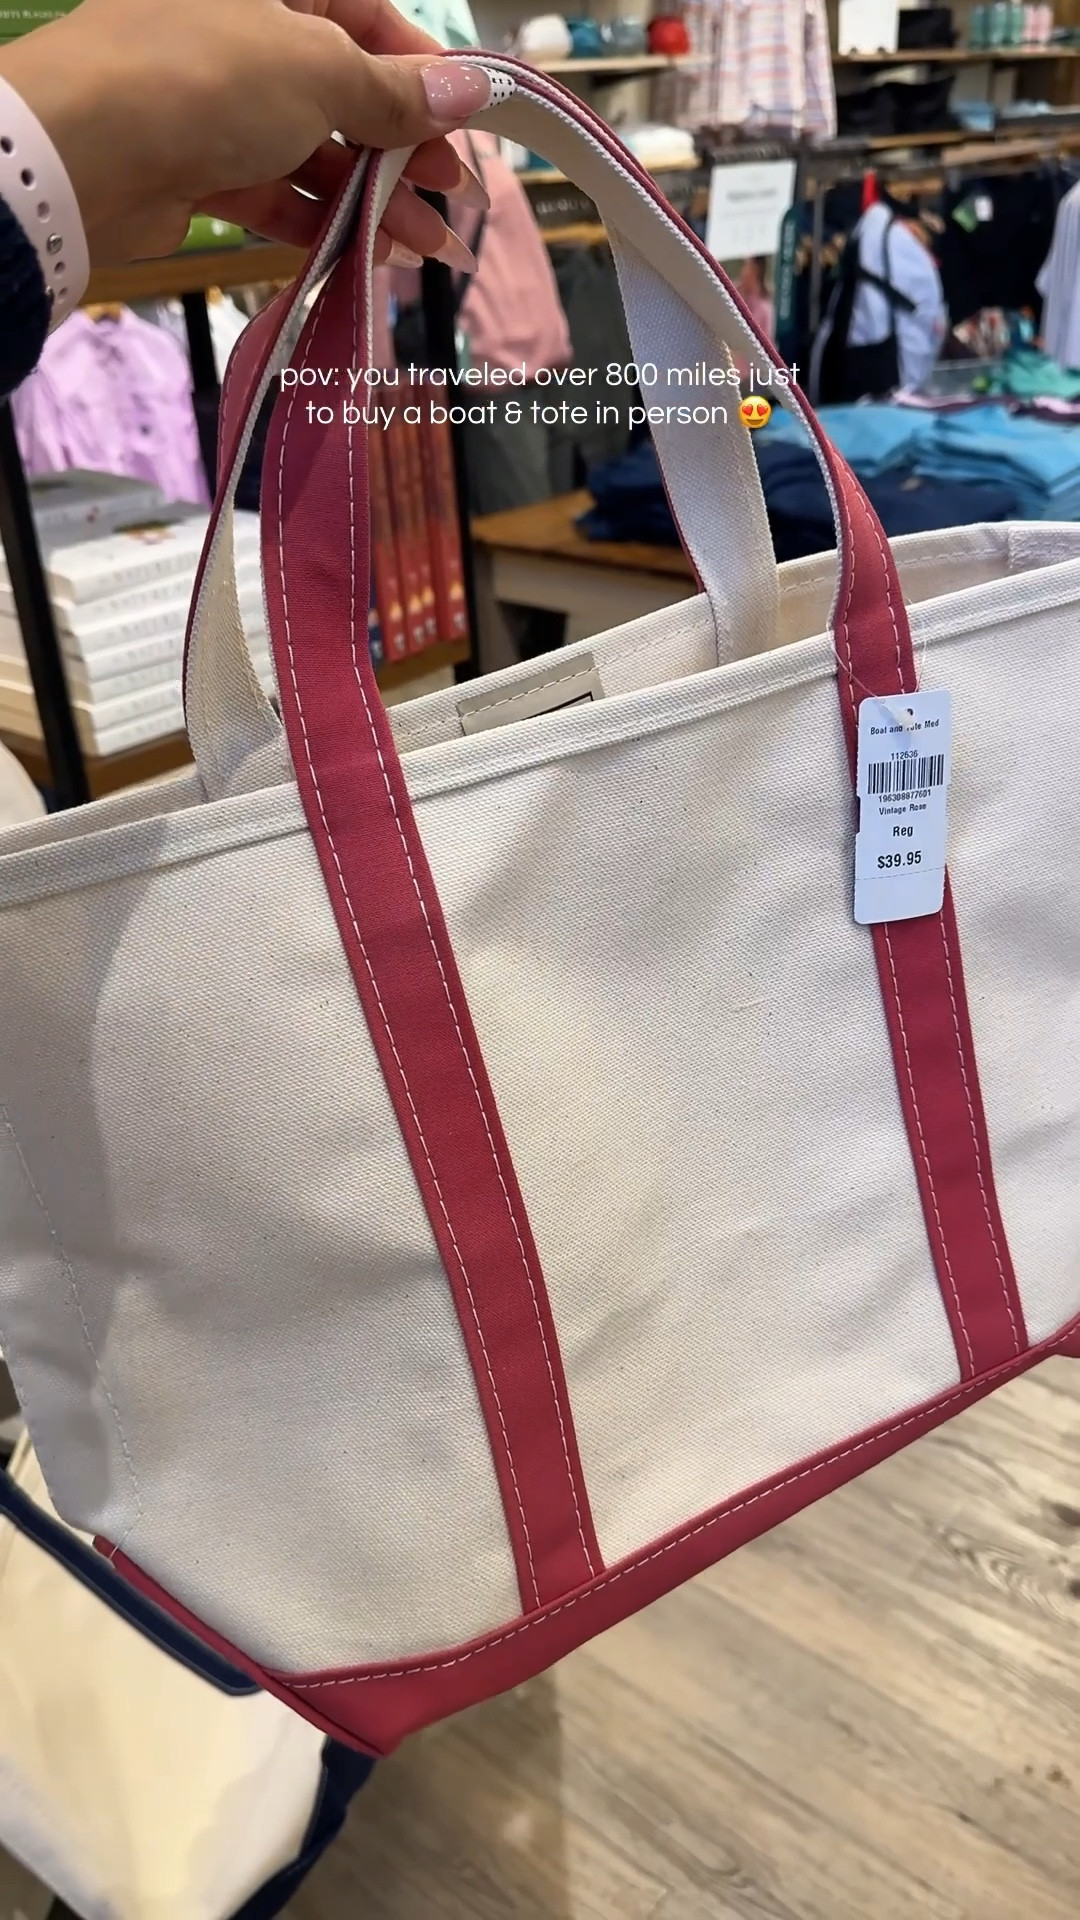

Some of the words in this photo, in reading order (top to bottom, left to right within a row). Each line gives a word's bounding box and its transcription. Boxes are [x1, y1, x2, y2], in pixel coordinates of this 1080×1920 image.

[870, 726, 887, 735] Boat
[889, 725, 903, 733] and
[924, 719, 940, 729] Med
[891, 750, 919, 760] 112636
[879, 789, 931, 803] 196308877601
[879, 806, 906, 815] Vintage
[909, 803, 927, 812] Rose
[892, 826, 914, 837] Reg
[877, 850, 922, 869] $39.95
